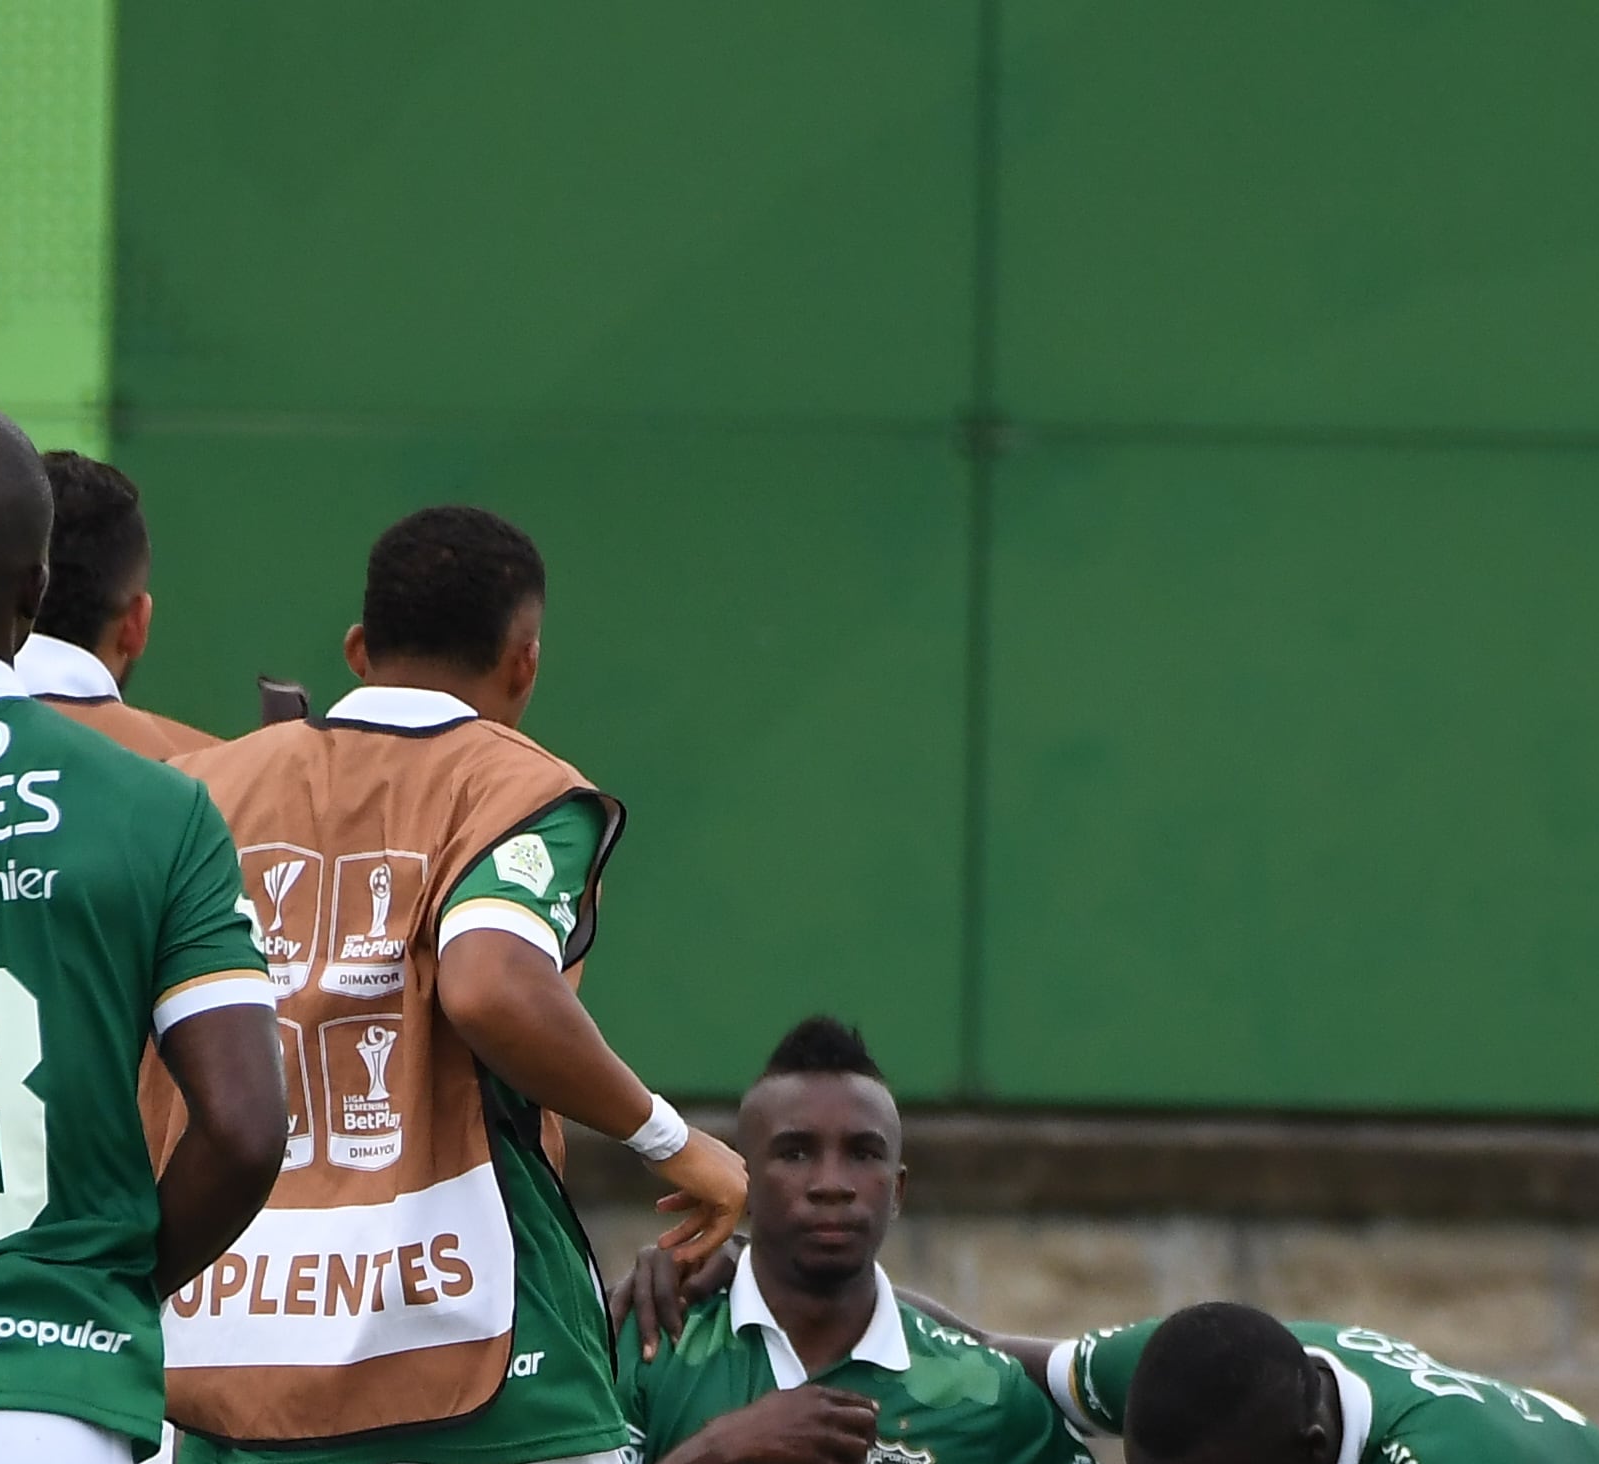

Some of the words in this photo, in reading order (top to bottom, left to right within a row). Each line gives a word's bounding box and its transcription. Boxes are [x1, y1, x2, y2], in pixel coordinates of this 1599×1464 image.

[339, 937, 405, 960] BetPlay
[343, 1110, 402, 1131] BetPlay
[172, 1233, 474, 1319] UPLENTES
